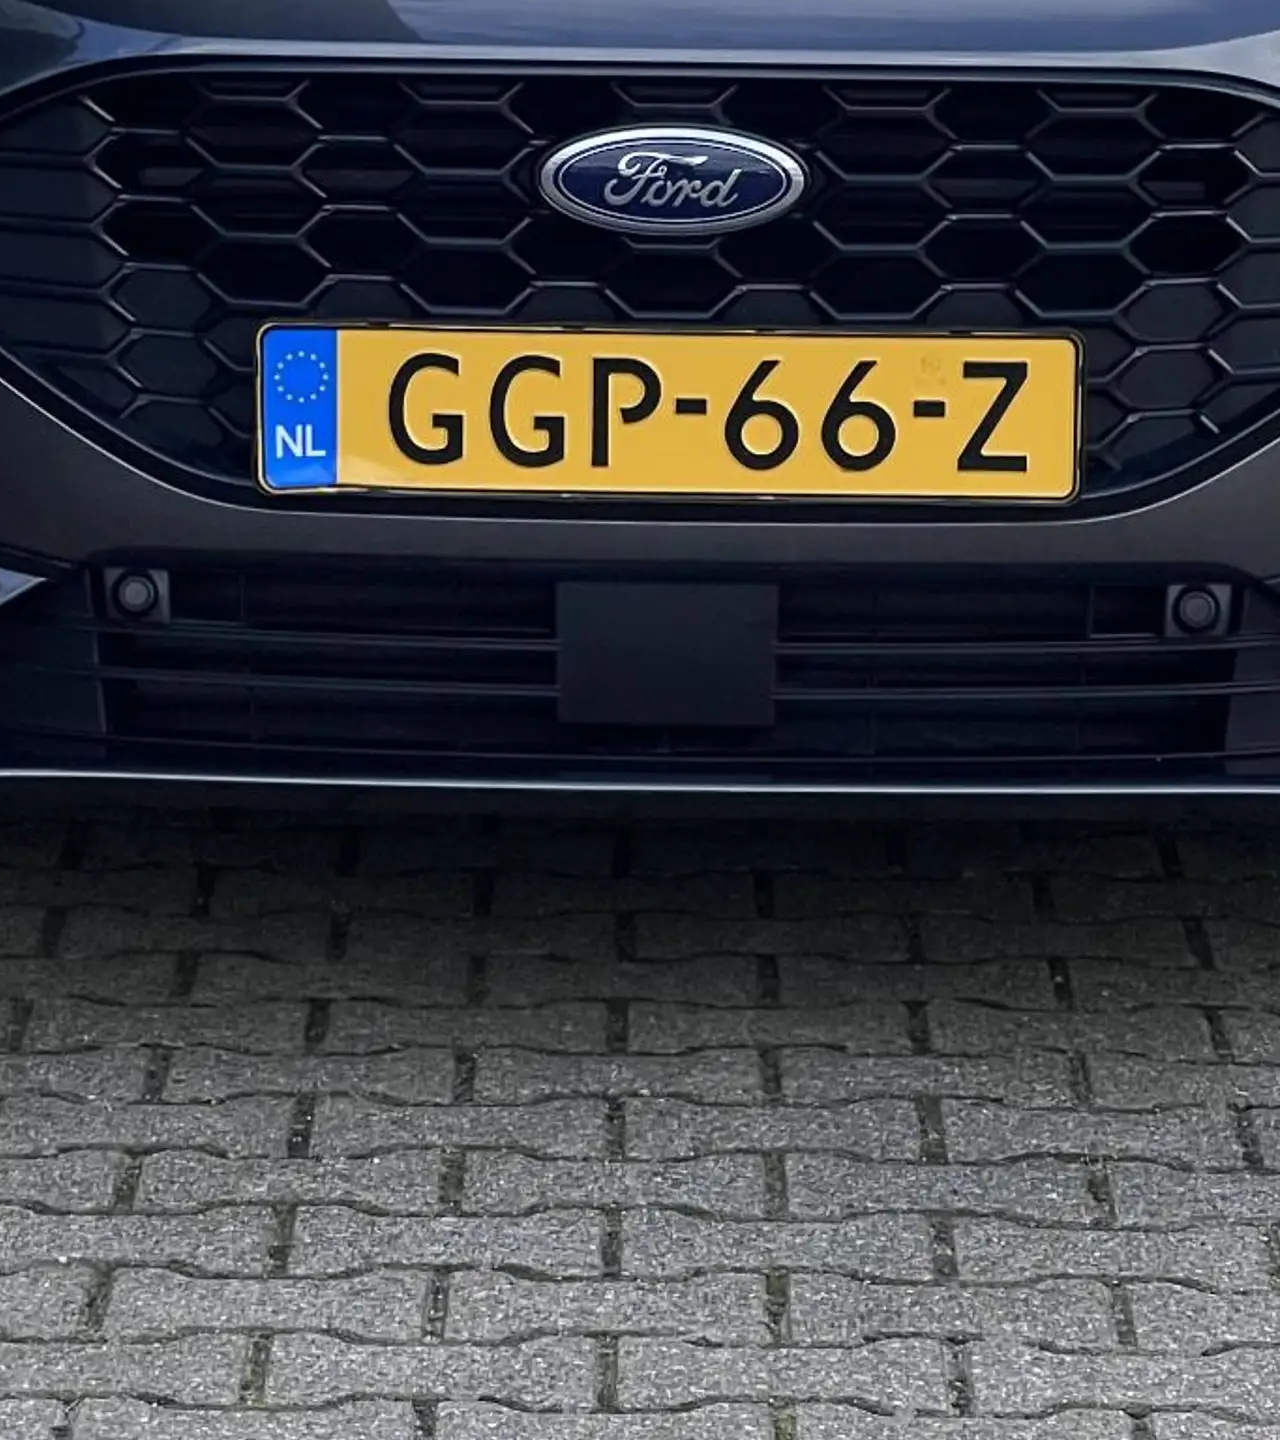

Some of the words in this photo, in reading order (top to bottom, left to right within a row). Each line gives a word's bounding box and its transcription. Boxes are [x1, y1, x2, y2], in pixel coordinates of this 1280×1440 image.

[604, 151, 742, 208] Ford
[274, 425, 326, 457] NL
[387, 353, 1029, 472] GGP-66-Z
